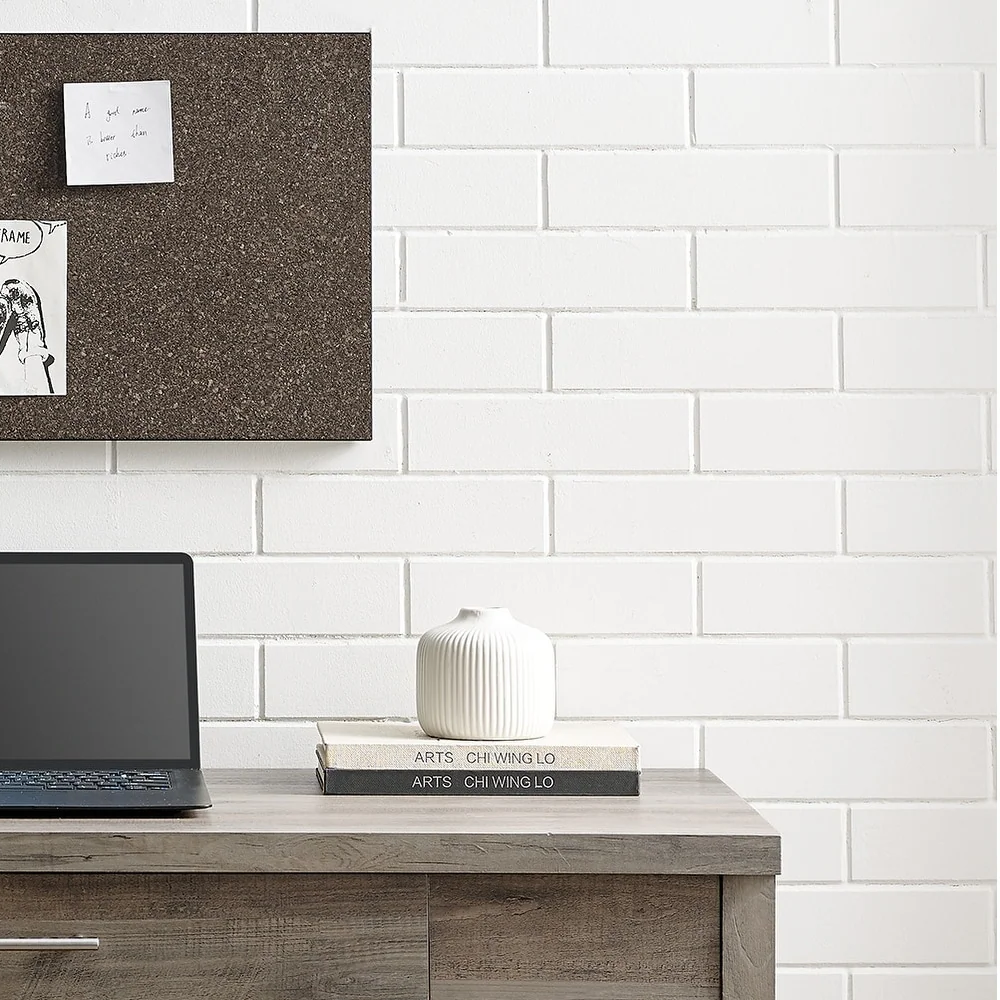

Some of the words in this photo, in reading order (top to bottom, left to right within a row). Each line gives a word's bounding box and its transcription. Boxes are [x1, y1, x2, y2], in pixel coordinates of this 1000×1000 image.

[84, 102, 91, 119] A
[414, 751, 454, 764] ARTS
[466, 751, 491, 764] CHI
[493, 752, 533, 765] WING
[536, 752, 556, 765] LO
[411, 775, 453, 788] ARTS
[464, 775, 489, 788] CHI
[491, 775, 531, 789] WING
[534, 775, 554, 789] LO
